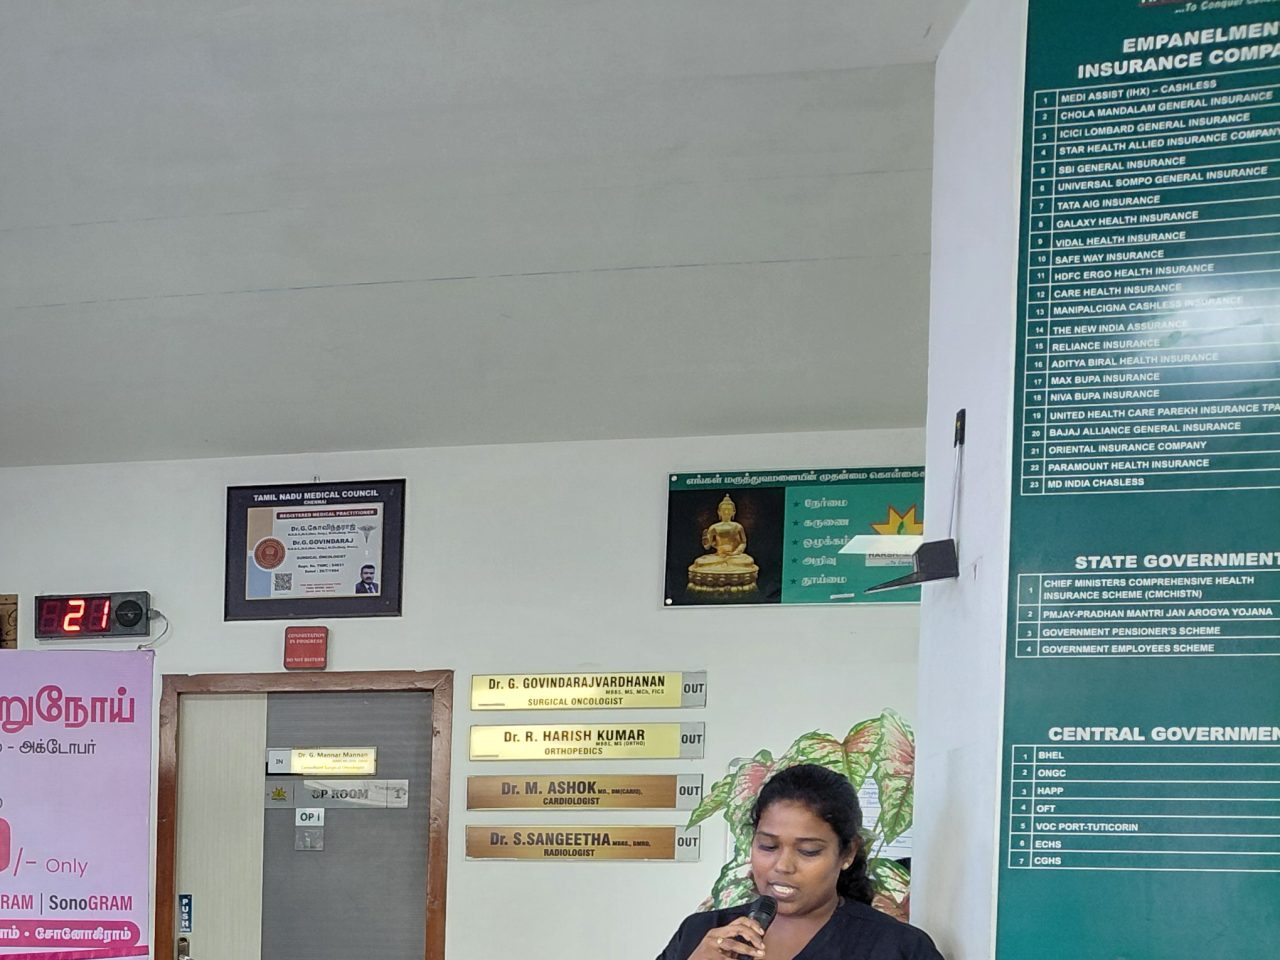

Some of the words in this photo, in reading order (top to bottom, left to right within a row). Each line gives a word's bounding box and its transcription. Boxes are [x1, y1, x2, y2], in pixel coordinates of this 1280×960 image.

[1123, 21, 1280, 53] EMPANELMEN
[1078, 53, 1202, 79] INSURANCE
[1061, 94, 1086, 104] MEDI
[1088, 90, 1123, 101] ASSIST
[1126, 88, 1150, 98] (IHX)
[1161, 80, 1217, 94] CASHLESS
[1050, 428, 1080, 438] BAJAJ
[1083, 426, 1131, 436] ALLIANCE
[1133, 424, 1181, 434] GENERAL
[1182, 422, 1241, 432] INSURANCE
[1048, 480, 1062, 489] MD
[1065, 479, 1090, 488] INDIA
[1093, 478, 1144, 487] CHASLESS
[304, 491, 340, 499] MEDICAL
[342, 490, 379, 498] COUNCIL
[1075, 555, 1138, 569] STATE
[1144, 552, 1280, 568] GOVERNMENT
[1044, 579, 1072, 588] CHIEF
[1075, 578, 1126, 588] MINISTERS
[1129, 576, 1213, 586] COMPREHENSIVE
[1215, 576, 1255, 585] HEALTH
[1044, 591, 1100, 601] INSURANCE
[1102, 590, 1143, 599] SCHEME
[1145, 589, 1202, 600] (CMCHISTN)
[64, 600, 110, 631] 21
[1043, 609, 1124, 619] PMJAY-PRADHAN
[1127, 609, 1164, 618] MANTRI
[1166, 608, 1185, 617] JAN
[1188, 608, 1230, 617] AROGYA
[1232, 607, 1273, 616] YOJANA
[1043, 628, 1110, 637] GOVERNMENT
[1179, 626, 1220, 635] SCHEME
[488, 679, 504, 690] Dr.
[508, 678, 519, 689] G.
[523, 676, 665, 689] GOVINDARAJVARDHANAN
[683, 683, 704, 694] OUT
[527, 698, 568, 706] SURGICAL
[571, 697, 624, 706] ONCOLOGIST
[504, 732, 520, 743] Dr.
[525, 732, 538, 742] R.
[543, 730, 592, 742] HARISH
[597, 729, 645, 741] KUMAR
[681, 734, 702, 744] OUT
[1049, 727, 1145, 742] CENTRAL
[19, 739, 96, 756] அக்டோபர்
[545, 747, 603, 755] ORTHOPEDICS
[1039, 751, 1064, 760] BHEL
[1038, 769, 1066, 778] ONGC
[501, 783, 520, 795] Dr.
[525, 782, 543, 795] M.
[548, 781, 596, 795] ASHOK
[679, 786, 700, 796] OUT
[1037, 787, 1064, 796] HAPP
[331, 789, 369, 799] ROOM
[1037, 805, 1056, 813] OFT
[301, 813, 314, 822] OP
[1036, 823, 1057, 831] VOC
[1059, 823, 1139, 832] PORT-TUTICORIN
[490, 833, 508, 845] Dr.
[677, 837, 698, 848] OUT
[1035, 840, 1062, 849] ECHS
[544, 849, 595, 857] RADIOLOGIST
[1034, 857, 1061, 866] CGHS
[45, 858, 88, 877] Only
[49, 895, 133, 911] SonoGRAM
[35, 926, 132, 943] சோனோகிராம்
